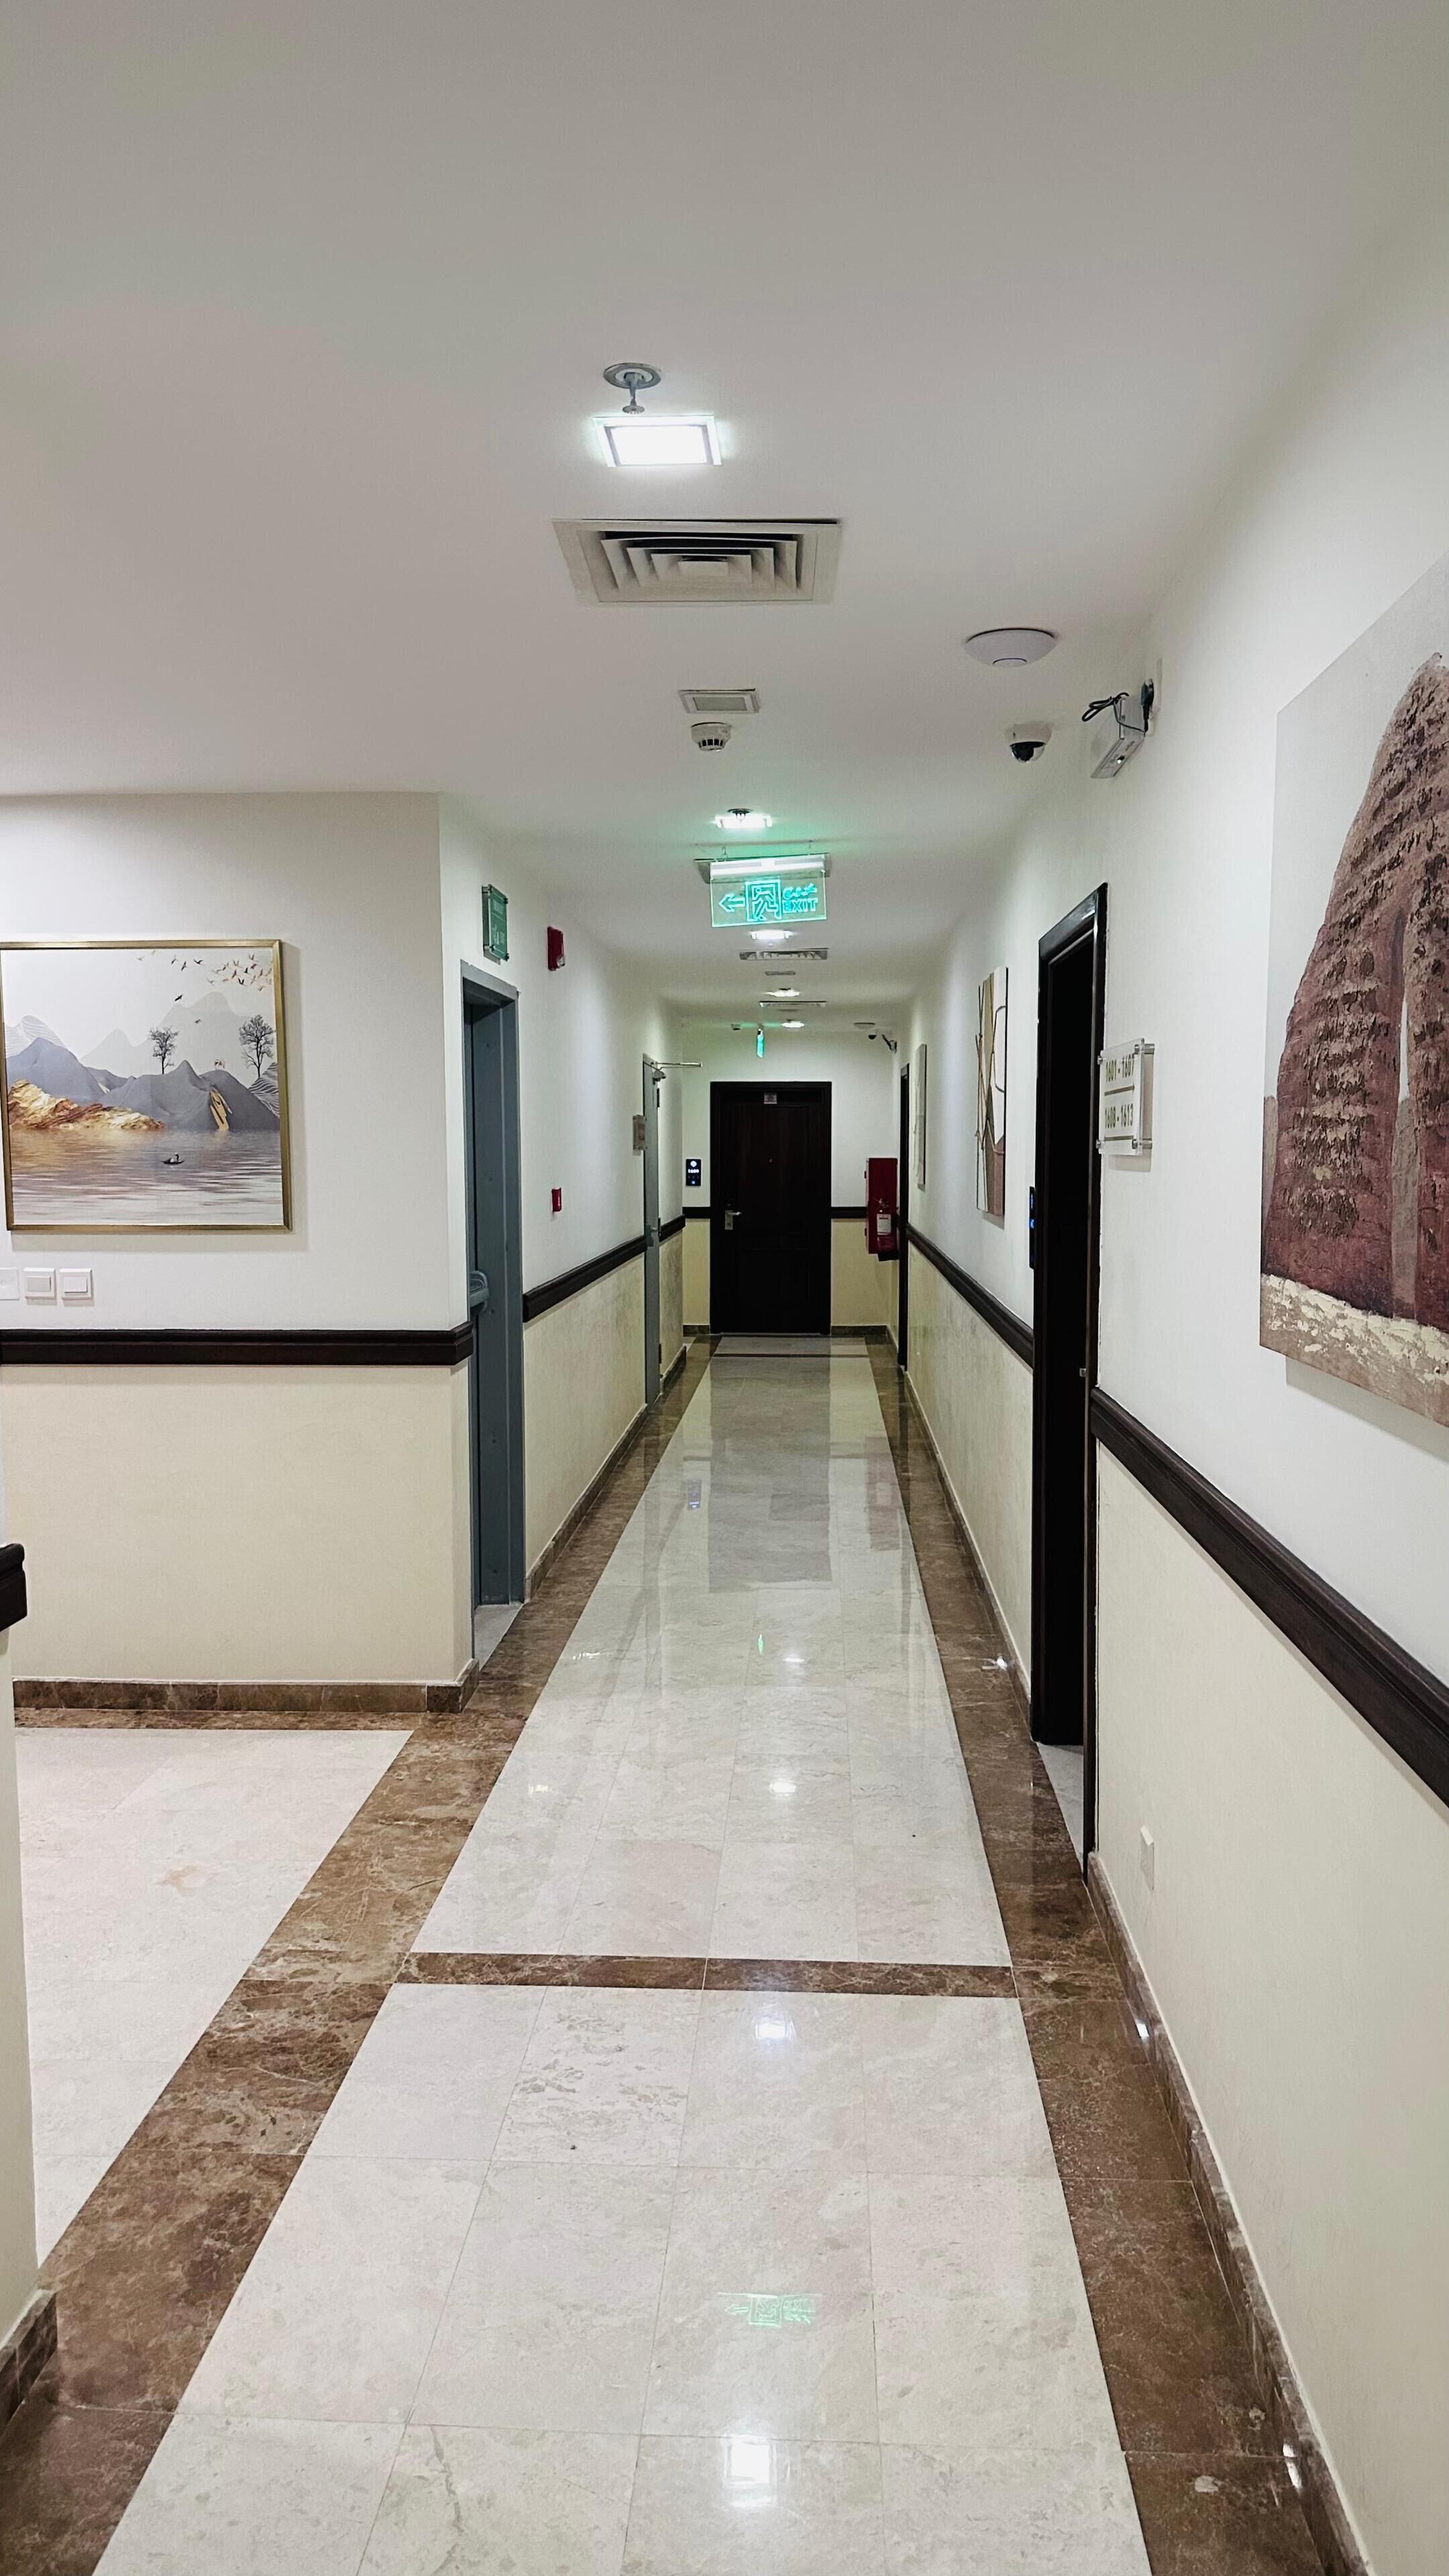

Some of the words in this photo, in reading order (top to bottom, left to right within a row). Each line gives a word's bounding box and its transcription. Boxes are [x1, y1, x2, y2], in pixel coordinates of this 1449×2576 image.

[782, 898, 818, 914] EXIT
[1106, 1059, 1117, 1083] 1601
[1122, 1053, 1135, 1079] 1607
[1105, 1106, 1116, 1129] 1608
[1120, 1103, 1134, 1128] 1613
